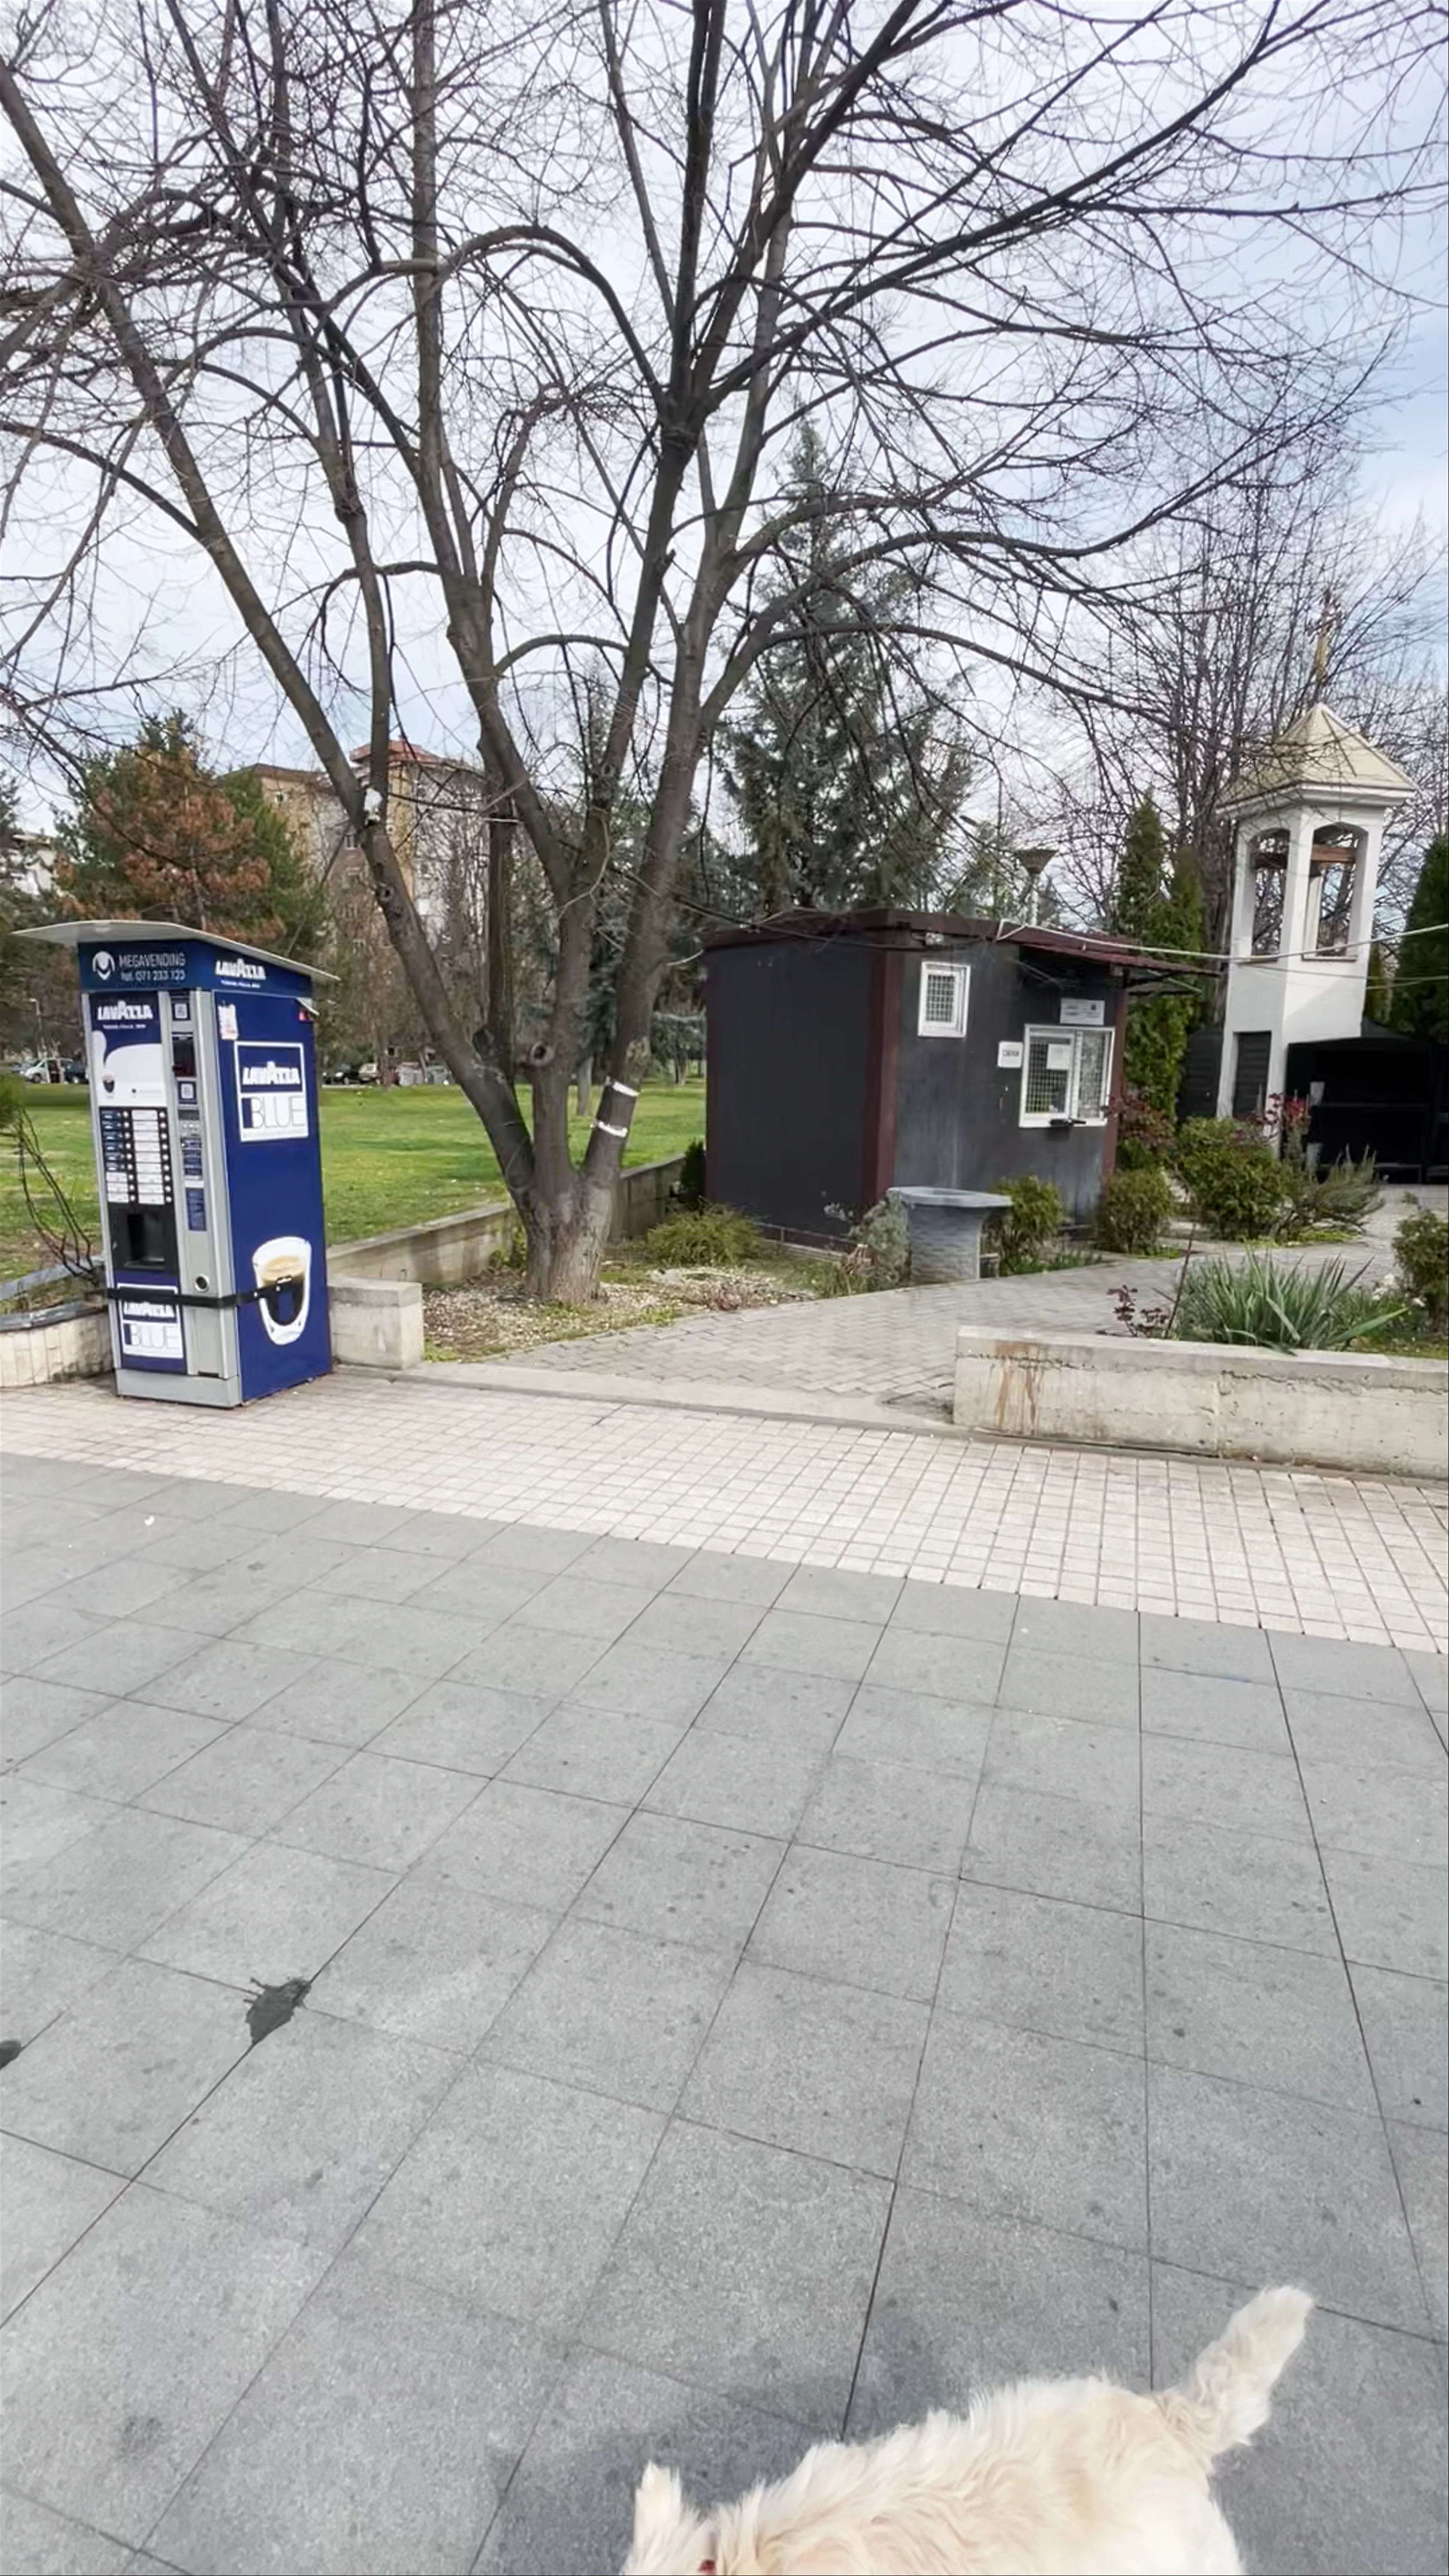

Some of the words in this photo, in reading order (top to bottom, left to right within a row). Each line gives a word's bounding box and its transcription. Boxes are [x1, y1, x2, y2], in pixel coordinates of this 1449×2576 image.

[118, 952, 186, 967] MEGAVENDING
[215, 958, 266, 980] LAVAZZA
[97, 1000, 153, 1020] LAVAZZA
[242, 1061, 300, 1085] LAVAZZA
[241, 1096, 305, 1129] BLUE
[123, 1323, 180, 1349] BLUE
